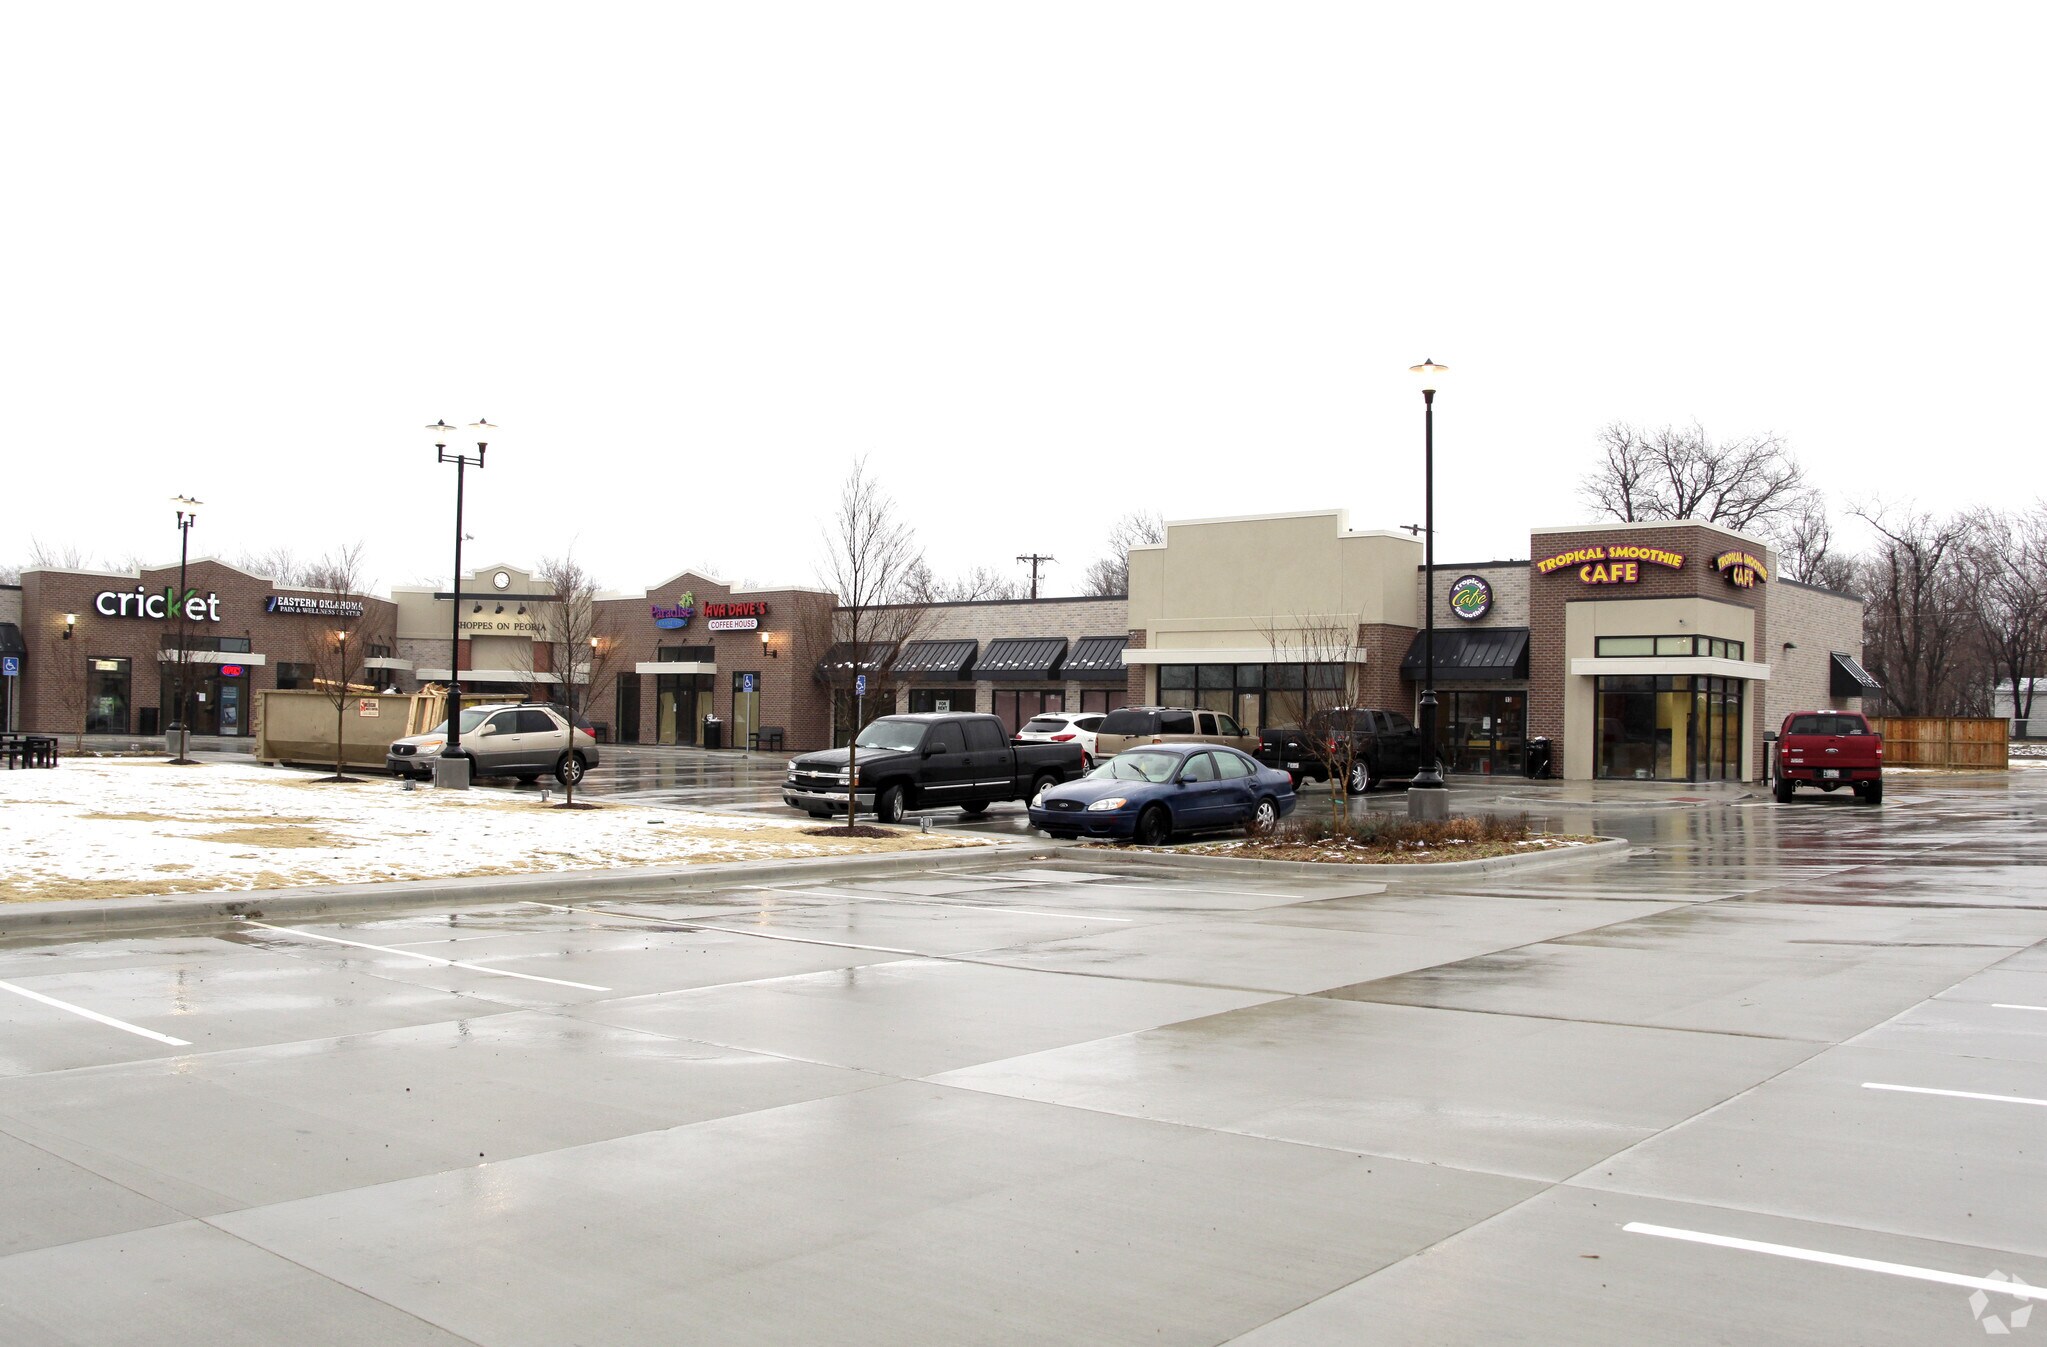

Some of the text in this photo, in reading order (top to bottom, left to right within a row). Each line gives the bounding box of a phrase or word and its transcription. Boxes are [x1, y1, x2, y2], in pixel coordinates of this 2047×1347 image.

[1537, 546, 1683, 573] TROPICAL SMOOTHIE
[1717, 551, 1768, 582] TROPICAL SMOOTHIE
[1580, 563, 1637, 582] CAFE
[1733, 565, 1754, 588] CAFE
[1453, 577, 1486, 591] Tropical
[96, 586, 220, 622] cricket
[277, 596, 364, 611] EASTERN OKLAHOMA
[302, 607, 336, 615] WELLNESS
[650, 603, 691, 619] Paradise
[702, 601, 766, 618] JAVA DAVE'S
[1454, 605, 1486, 618] Smoothie
[458, 621, 547, 632] HOPPES ON PEORIA
[710, 619, 755, 629] COFFEE HOUSE
